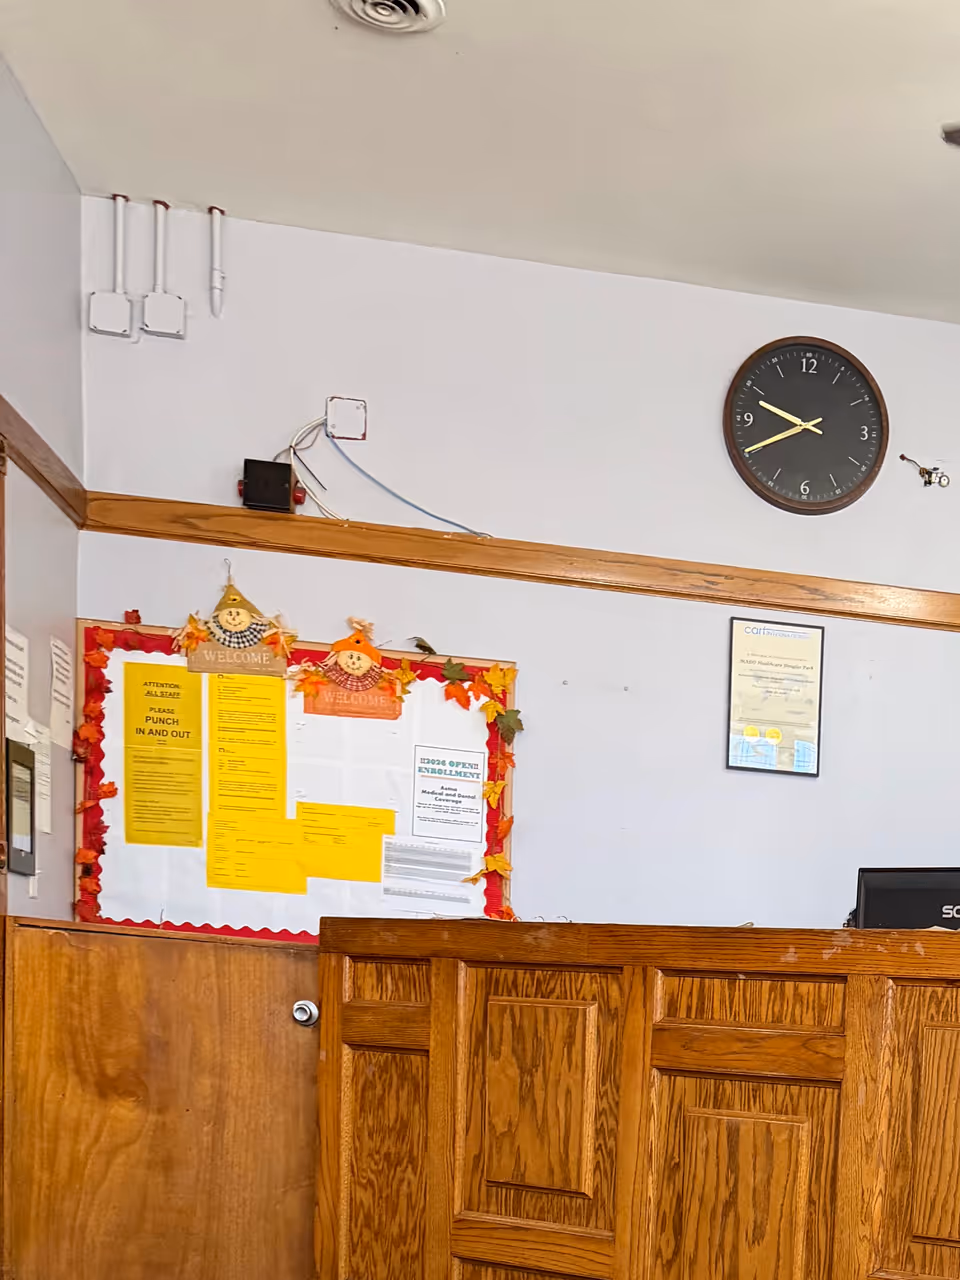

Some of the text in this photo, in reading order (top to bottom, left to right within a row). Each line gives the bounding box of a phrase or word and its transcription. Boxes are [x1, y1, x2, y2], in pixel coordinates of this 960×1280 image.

[800, 358, 818, 373] 12
[743, 412, 754, 427] 9
[859, 425, 869, 441] 3
[800, 480, 811, 494] 6
[203, 650, 270, 664] WELCOME
[323, 690, 388, 706] WELCOME
[149, 706, 175, 714] PLEASE
[145, 715, 179, 726] PUNCH
[135, 727, 191, 739] IN AND OUT
[417, 766, 482, 780] ENROLLMENT
[434, 796, 463, 805] Coverage
